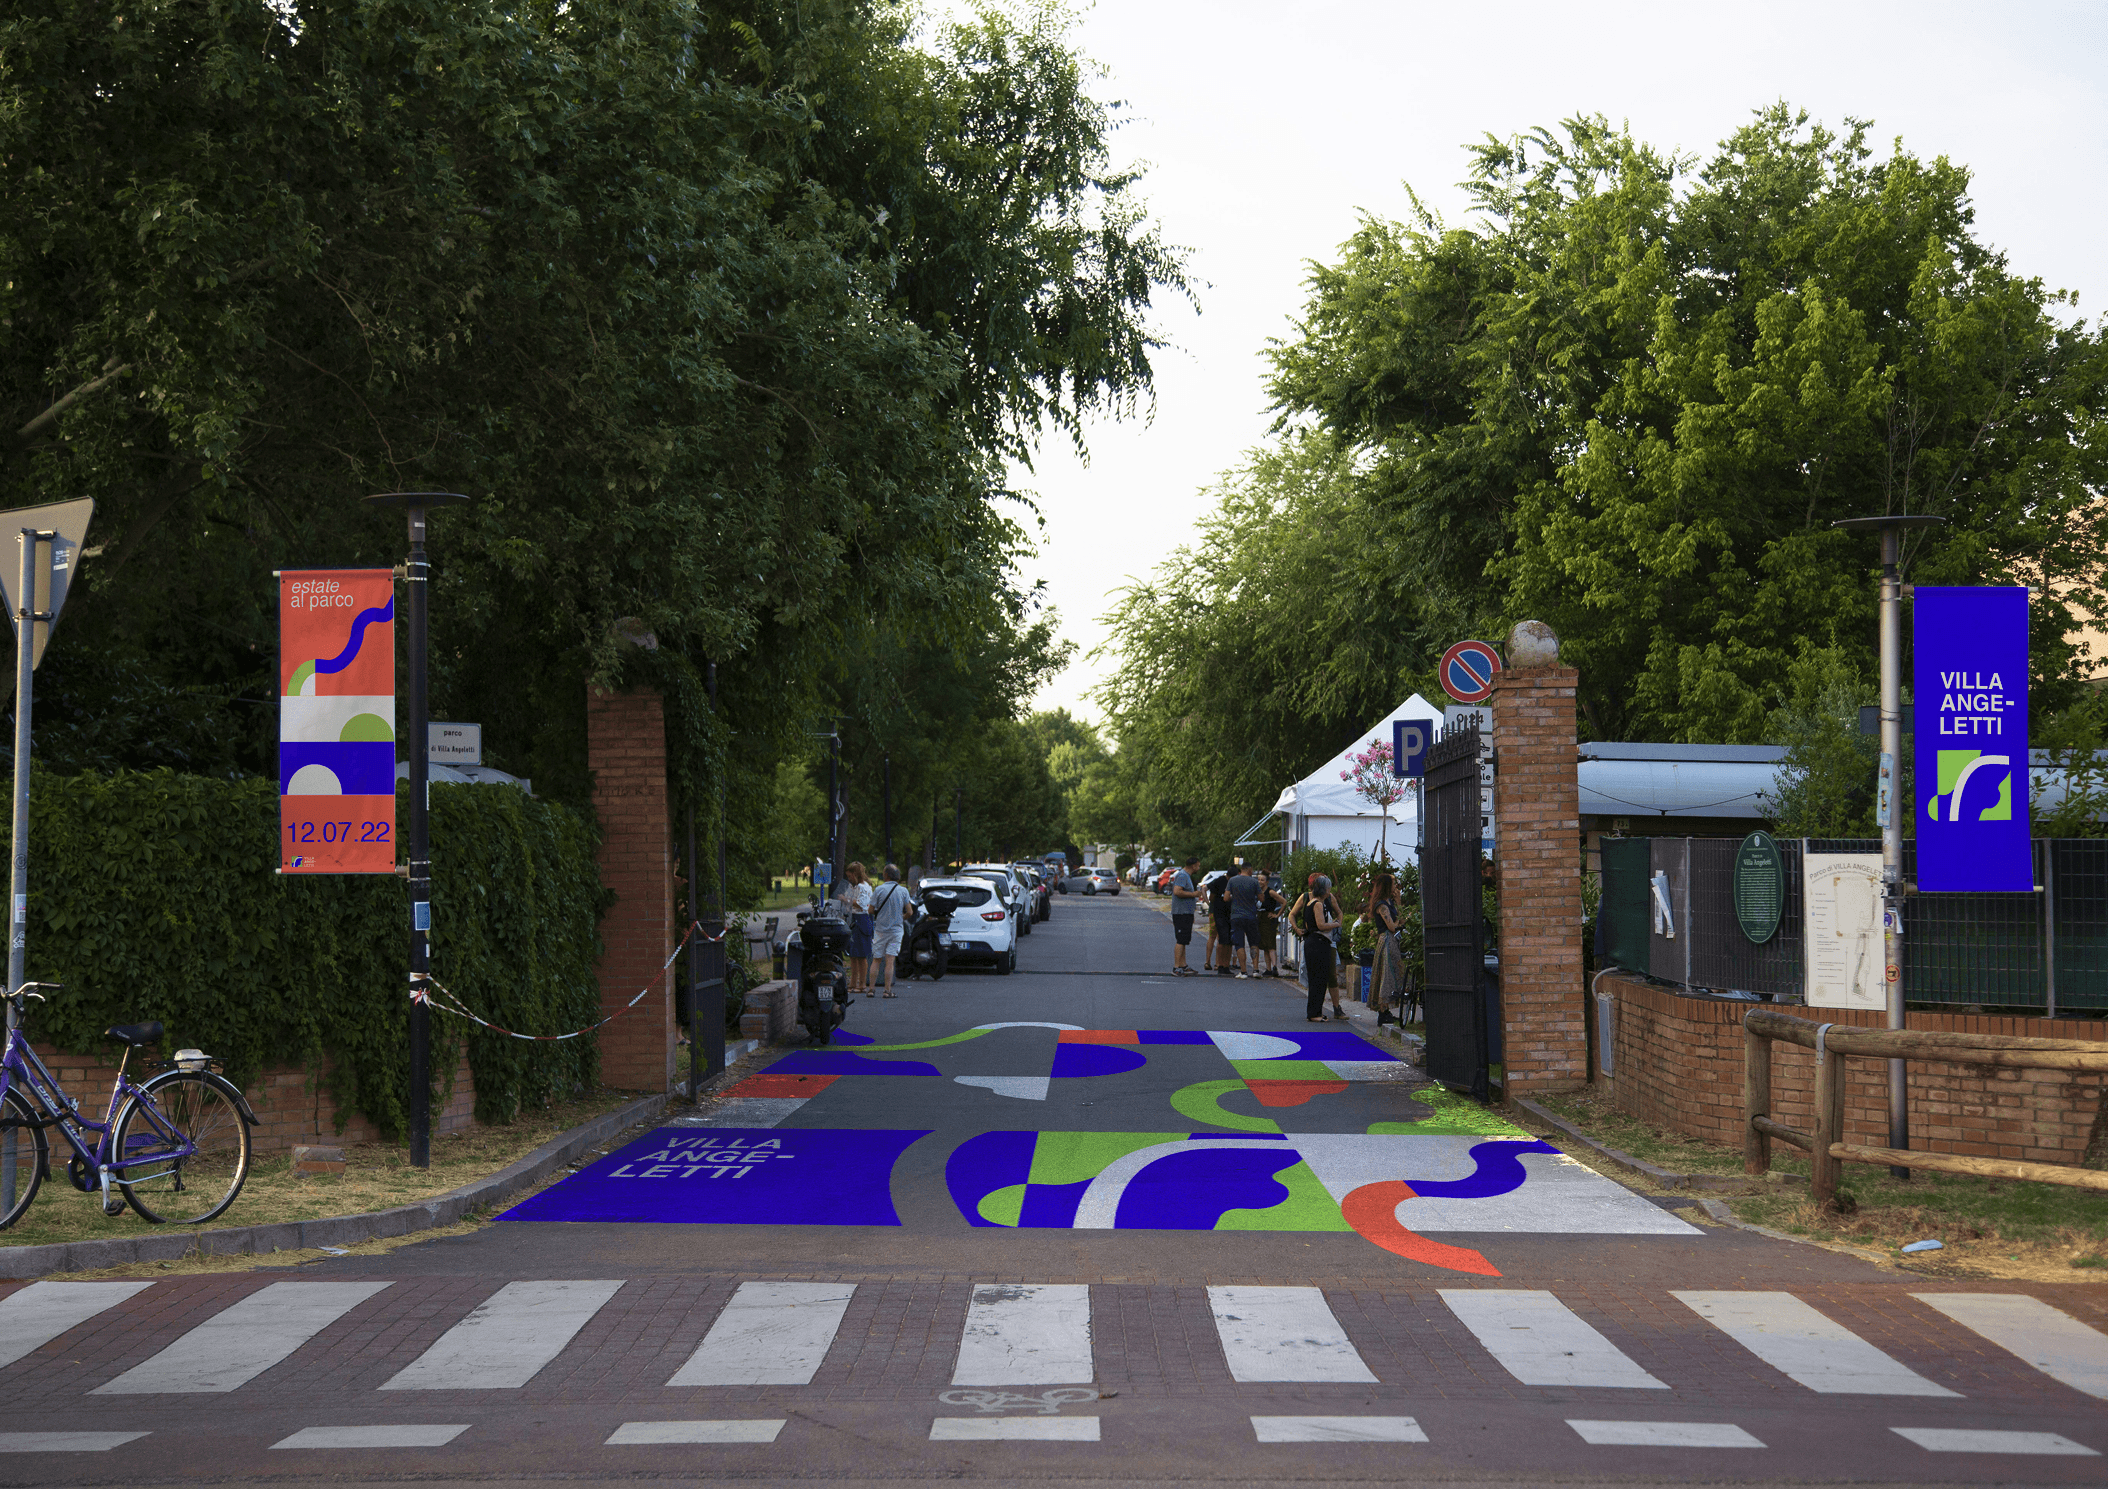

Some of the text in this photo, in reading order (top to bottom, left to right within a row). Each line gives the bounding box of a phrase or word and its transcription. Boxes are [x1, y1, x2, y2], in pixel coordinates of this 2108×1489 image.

[291, 579, 340, 594] estate
[291, 590, 354, 612] al parco
[1940, 671, 2003, 690] VILLA
[1940, 694, 2015, 712] ANGE-
[1940, 716, 2002, 735] LETTI
[452, 745, 475, 754] Angeletti
[1401, 726, 1424, 771] P
[287, 821, 390, 843] 12.07.22
[1809, 868, 1827, 880] Parco
[1833, 862, 1852, 870] VILLA
[667, 1137, 781, 1149] VILLA
[634, 1150, 795, 1163] ANGE-
[607, 1164, 754, 1178] LETTI
